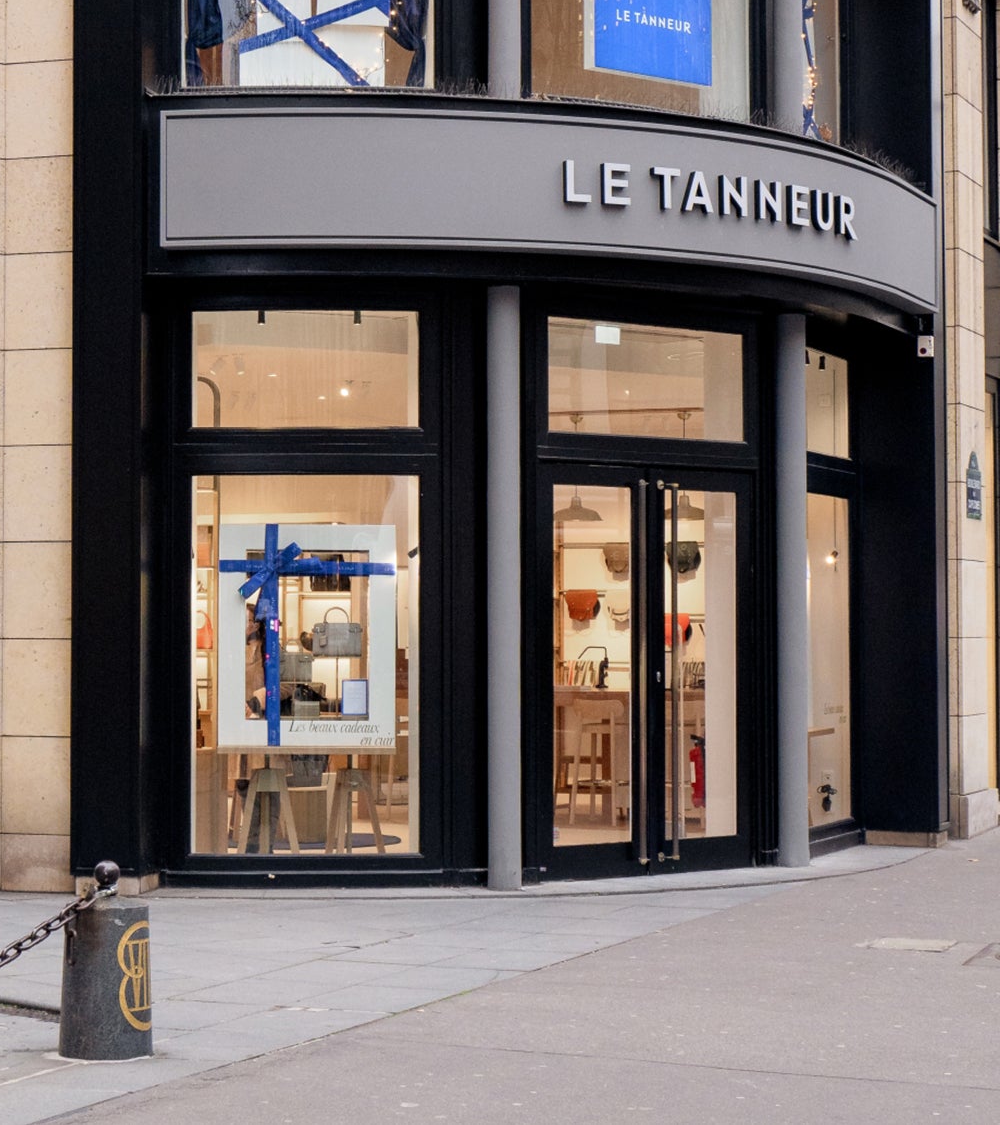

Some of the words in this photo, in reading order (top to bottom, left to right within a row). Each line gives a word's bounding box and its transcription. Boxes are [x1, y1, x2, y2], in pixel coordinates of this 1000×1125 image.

[616, 9, 631, 22] LE
[634, 12, 691, 34] TANNEUR
[562, 160, 632, 206] LE
[650, 167, 858, 241] TANNEUR
[309, 720, 337, 733] beaux
[340, 721, 380, 734] cadeaux
[360, 737, 372, 745] en
